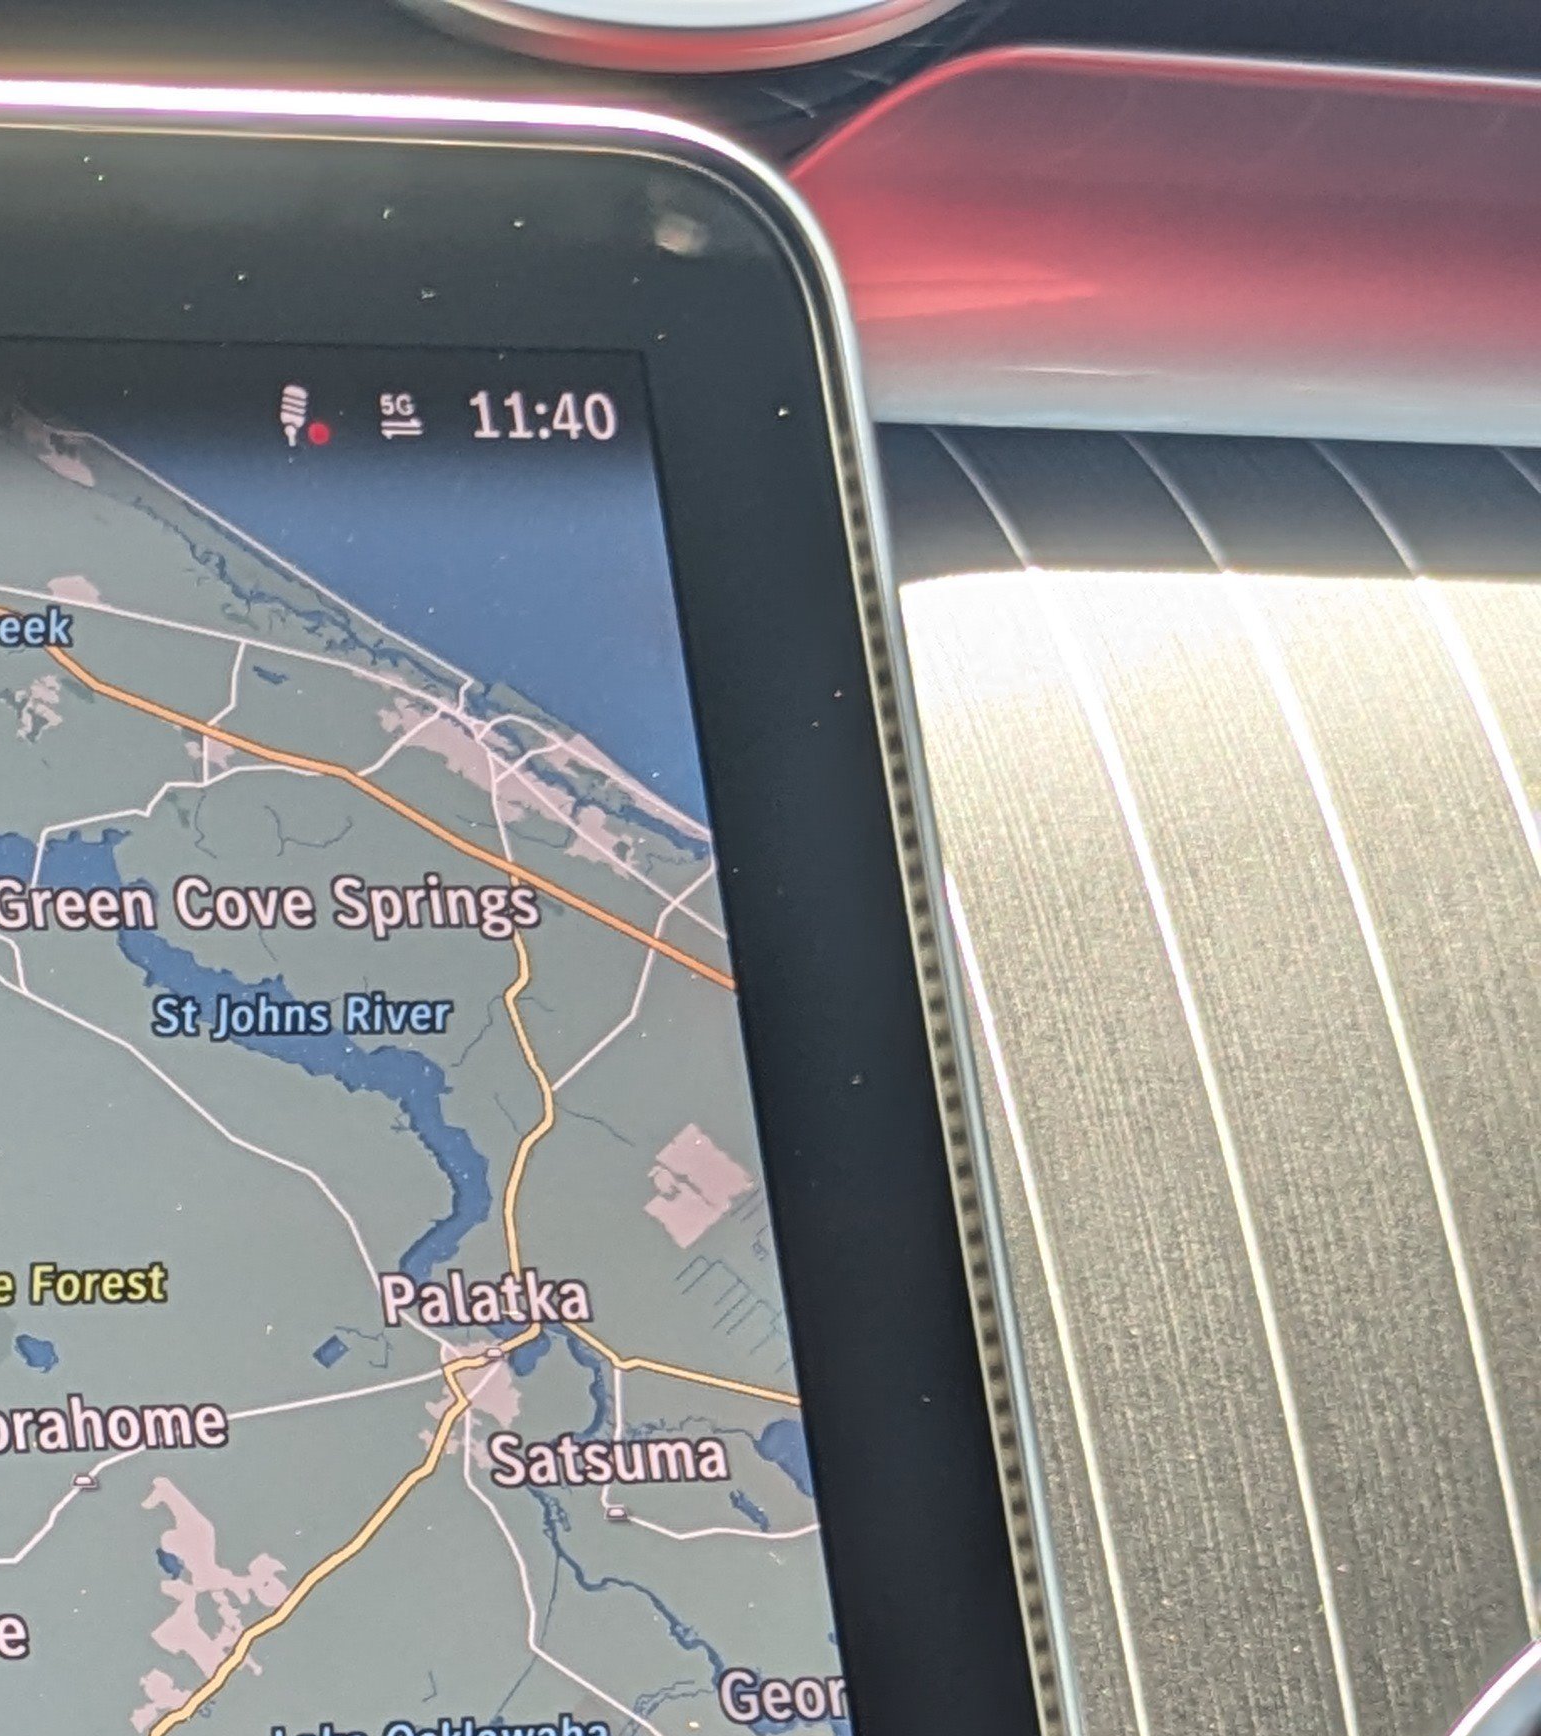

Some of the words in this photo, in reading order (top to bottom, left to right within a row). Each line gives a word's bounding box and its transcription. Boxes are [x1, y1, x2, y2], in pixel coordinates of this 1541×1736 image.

[380, 393, 415, 416] 5G
[469, 390, 616, 441] 11:40
[174, 877, 315, 929] Cove
[331, 873, 540, 942] Springs
[152, 997, 201, 1039] St
[212, 997, 331, 1040] Johns
[343, 994, 453, 1036] River
[29, 1262, 170, 1305] Forest
[379, 1271, 594, 1327] Palatka
[487, 1432, 730, 1489] Satsuma
[719, 1667, 847, 1724] Geor
